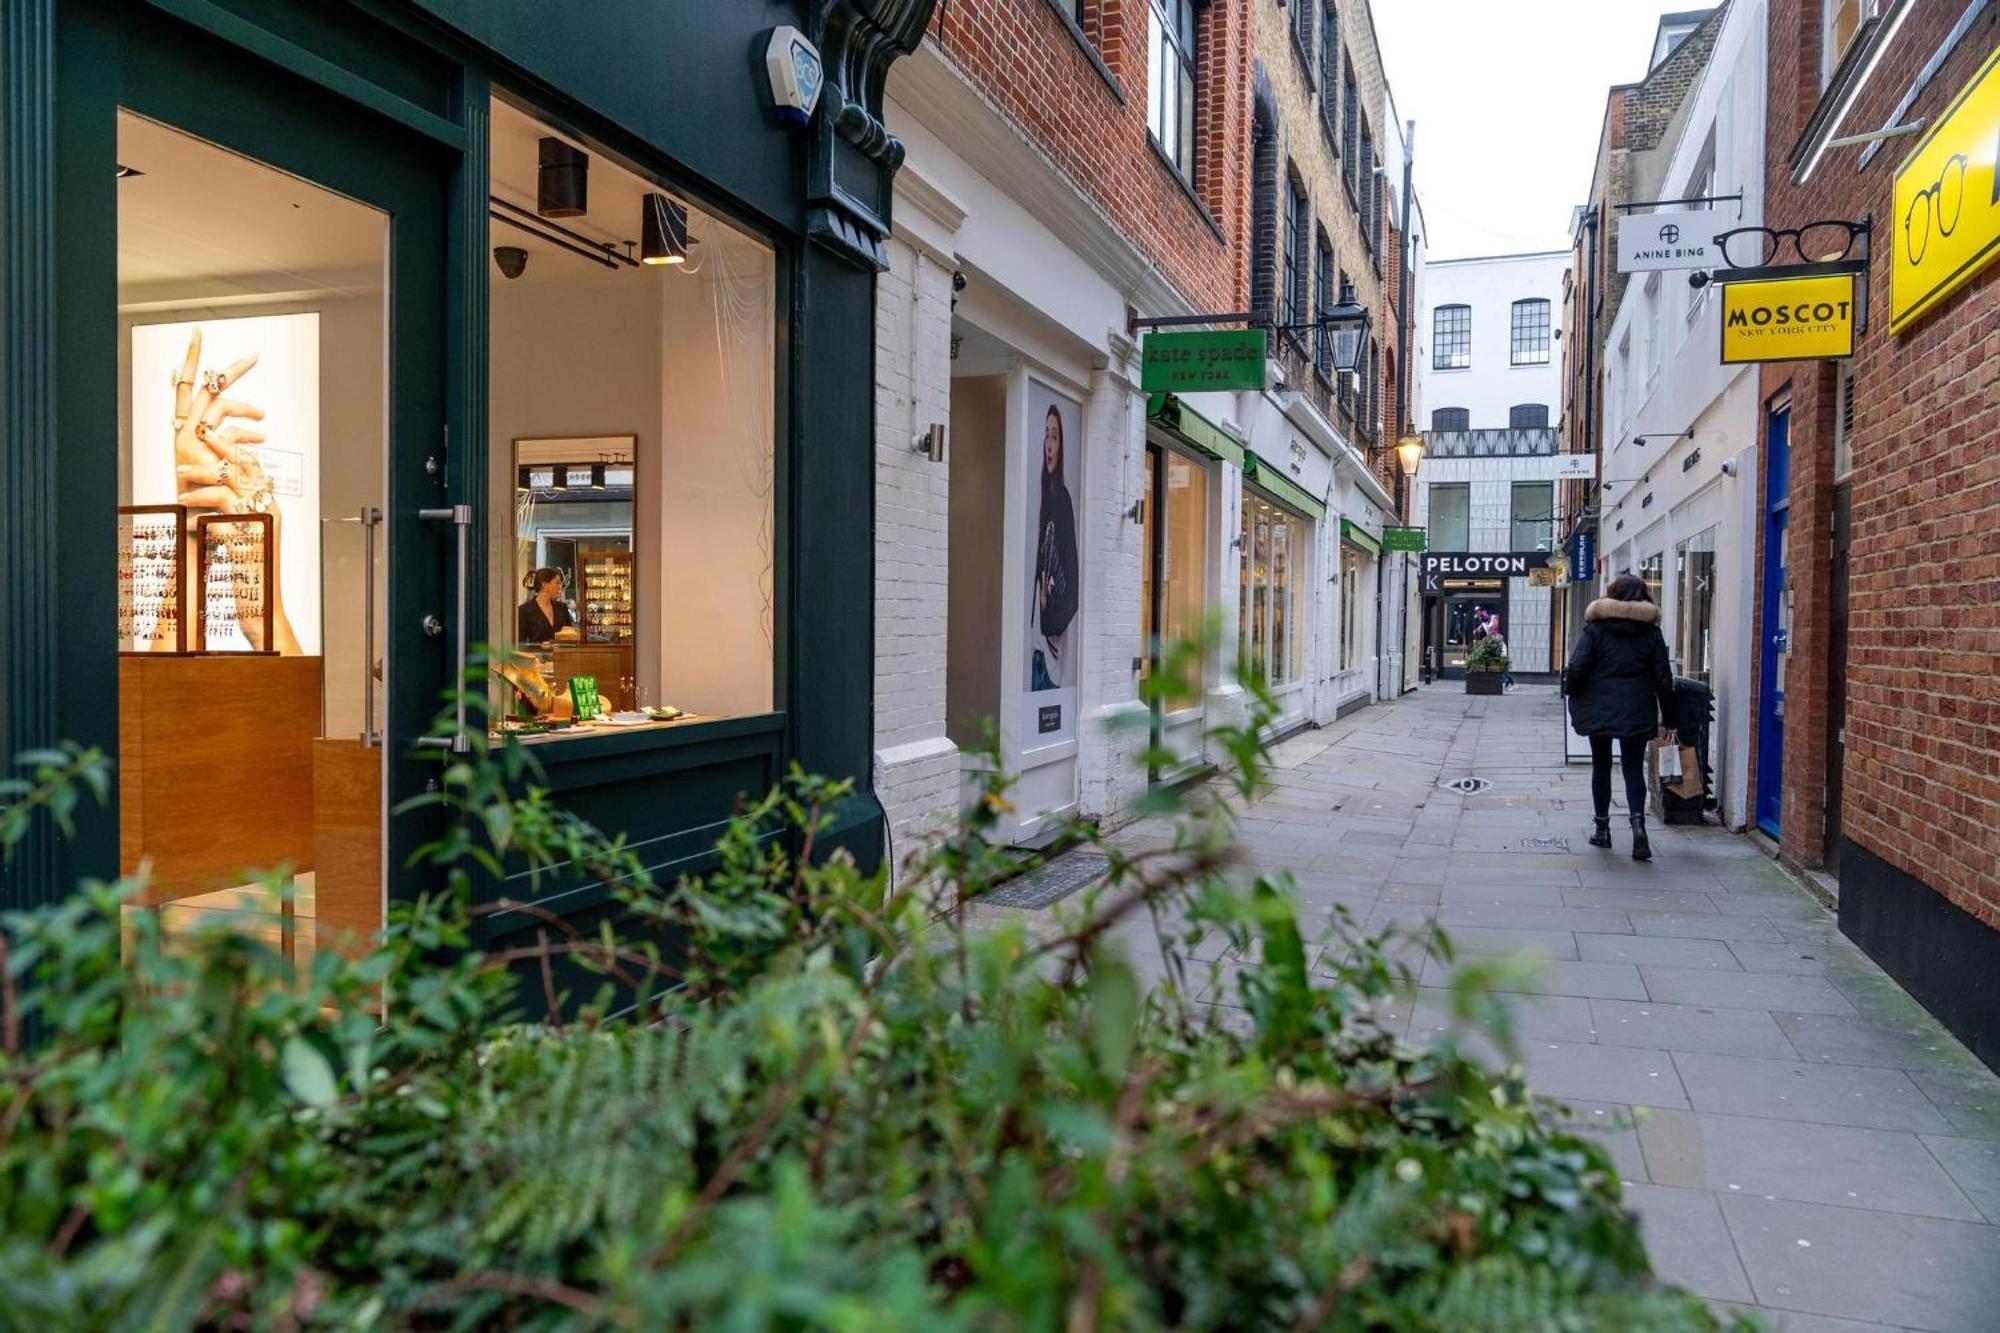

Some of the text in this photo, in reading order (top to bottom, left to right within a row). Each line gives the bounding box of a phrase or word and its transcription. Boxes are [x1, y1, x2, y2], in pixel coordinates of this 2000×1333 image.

[1634, 247, 1704, 260] ANINE BING
[1727, 301, 1850, 327] MOSCOT
[1739, 324, 1837, 337] NEW YORK CITY
[1148, 341, 1258, 367] kate spade
[1427, 557, 1526, 572] PELOTON
[1425, 574, 1439, 590] K
